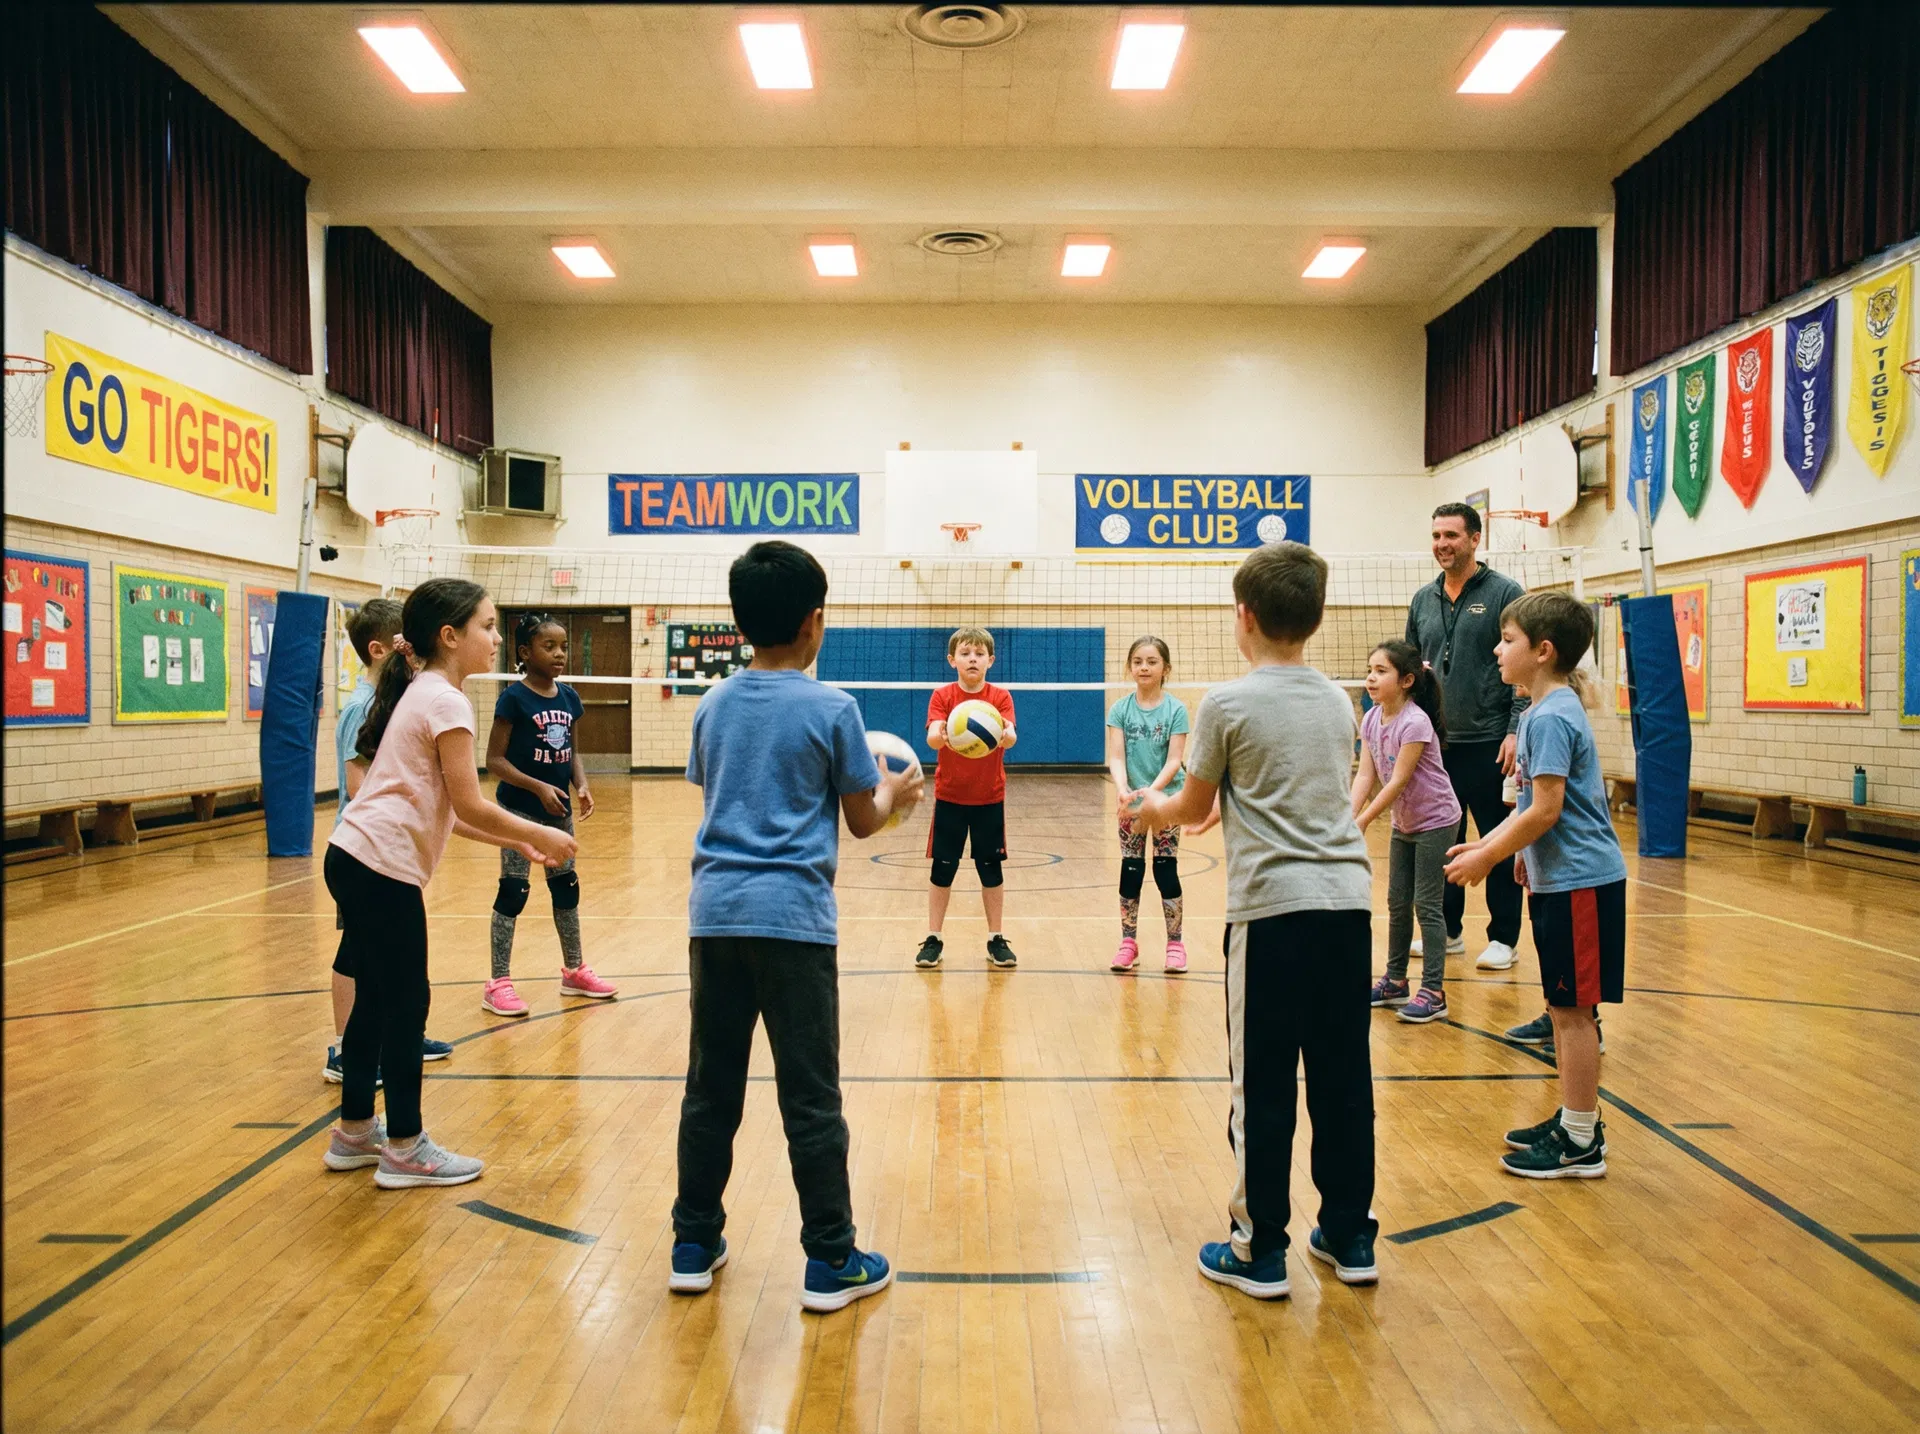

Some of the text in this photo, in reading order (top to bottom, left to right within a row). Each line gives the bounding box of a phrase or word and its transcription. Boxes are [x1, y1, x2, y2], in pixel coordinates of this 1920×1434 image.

[63, 361, 270, 497] GO TIGERS!
[615, 481, 853, 526] TEAMWORK
[1081, 479, 1304, 510] VOLLEYBALL
[1148, 514, 1239, 544] CLUB
